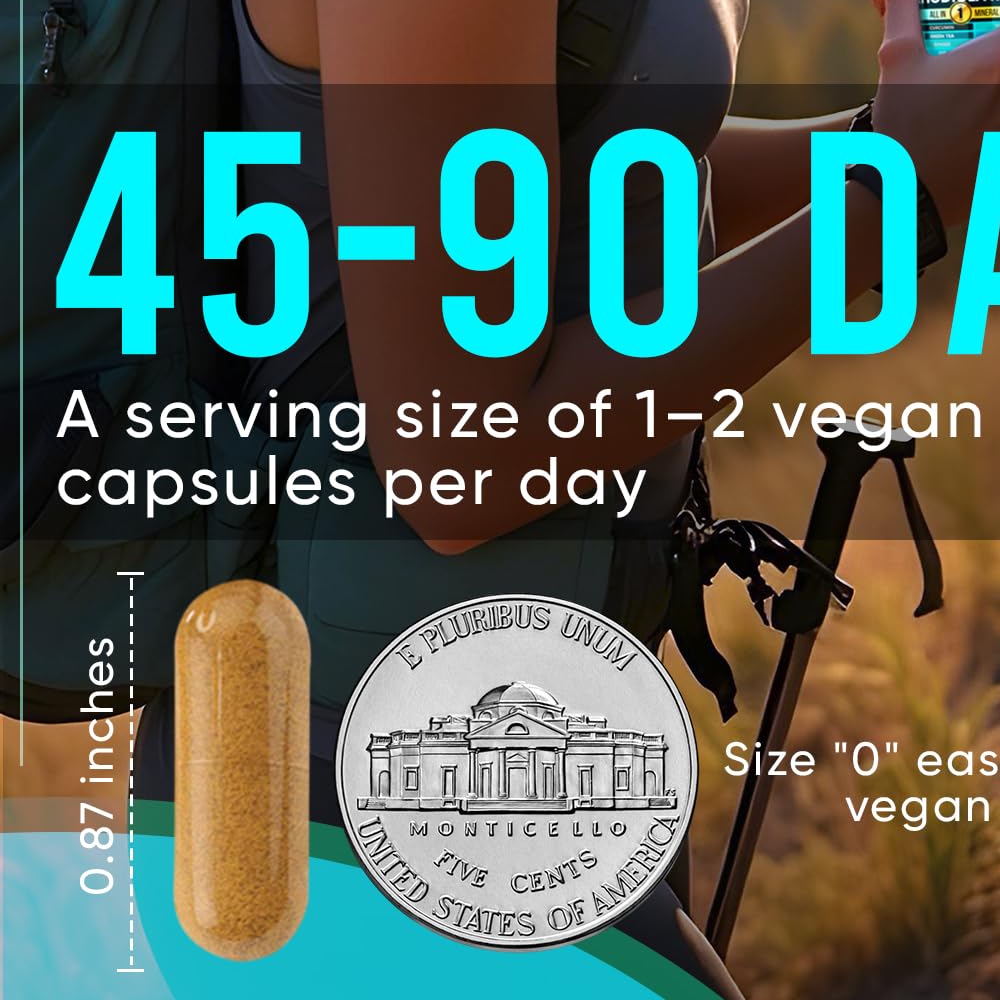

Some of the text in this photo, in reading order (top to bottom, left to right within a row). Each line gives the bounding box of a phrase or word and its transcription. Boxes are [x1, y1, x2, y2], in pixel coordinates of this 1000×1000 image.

[974, 8, 1000, 17] MINERAL
[396, 604, 638, 671] E PLURIBUS UNUM
[409, 820, 628, 837] MONTICELLO
[357, 815, 680, 937] UNITED STATES OF AMERICA
[433, 849, 598, 893] FIVE CENTS
